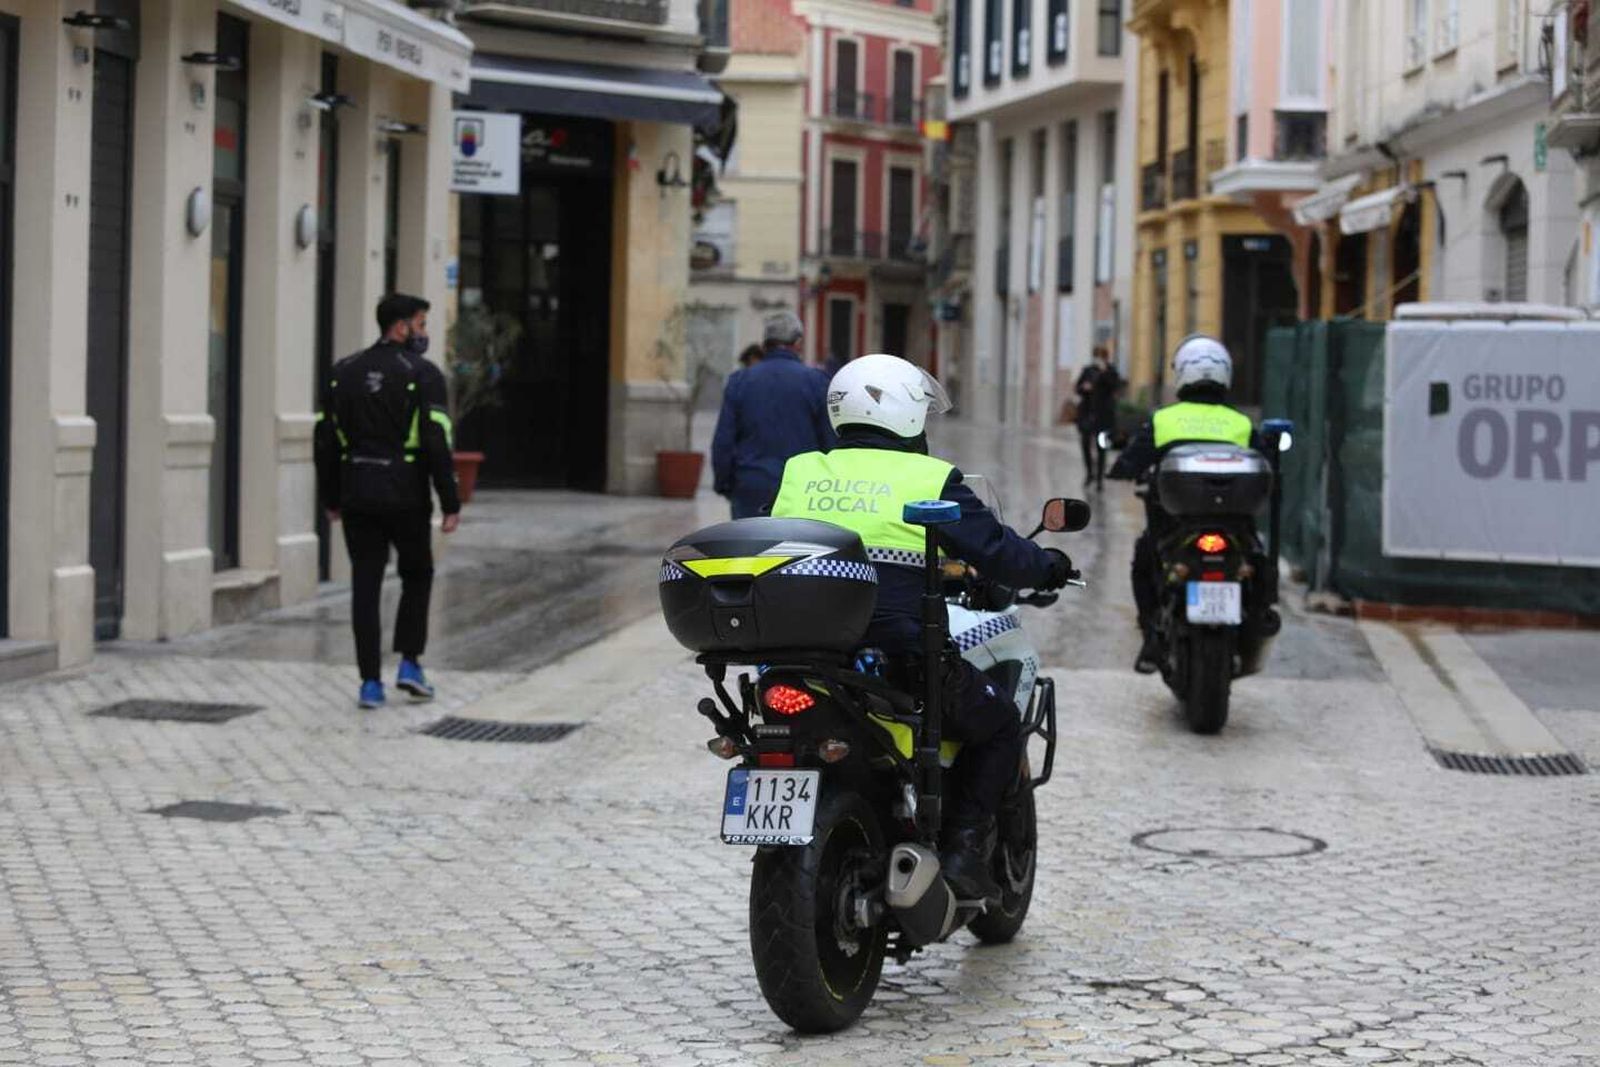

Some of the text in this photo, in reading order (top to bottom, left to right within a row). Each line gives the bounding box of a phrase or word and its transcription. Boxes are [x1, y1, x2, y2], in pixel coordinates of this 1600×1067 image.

[1462, 373, 1566, 402] GRUPO
[805, 479, 892, 497] POLICIA
[807, 496, 879, 514] LOCAL
[754, 777, 810, 802] 1134
[733, 796, 743, 807] E
[746, 805, 793, 829] KKR
